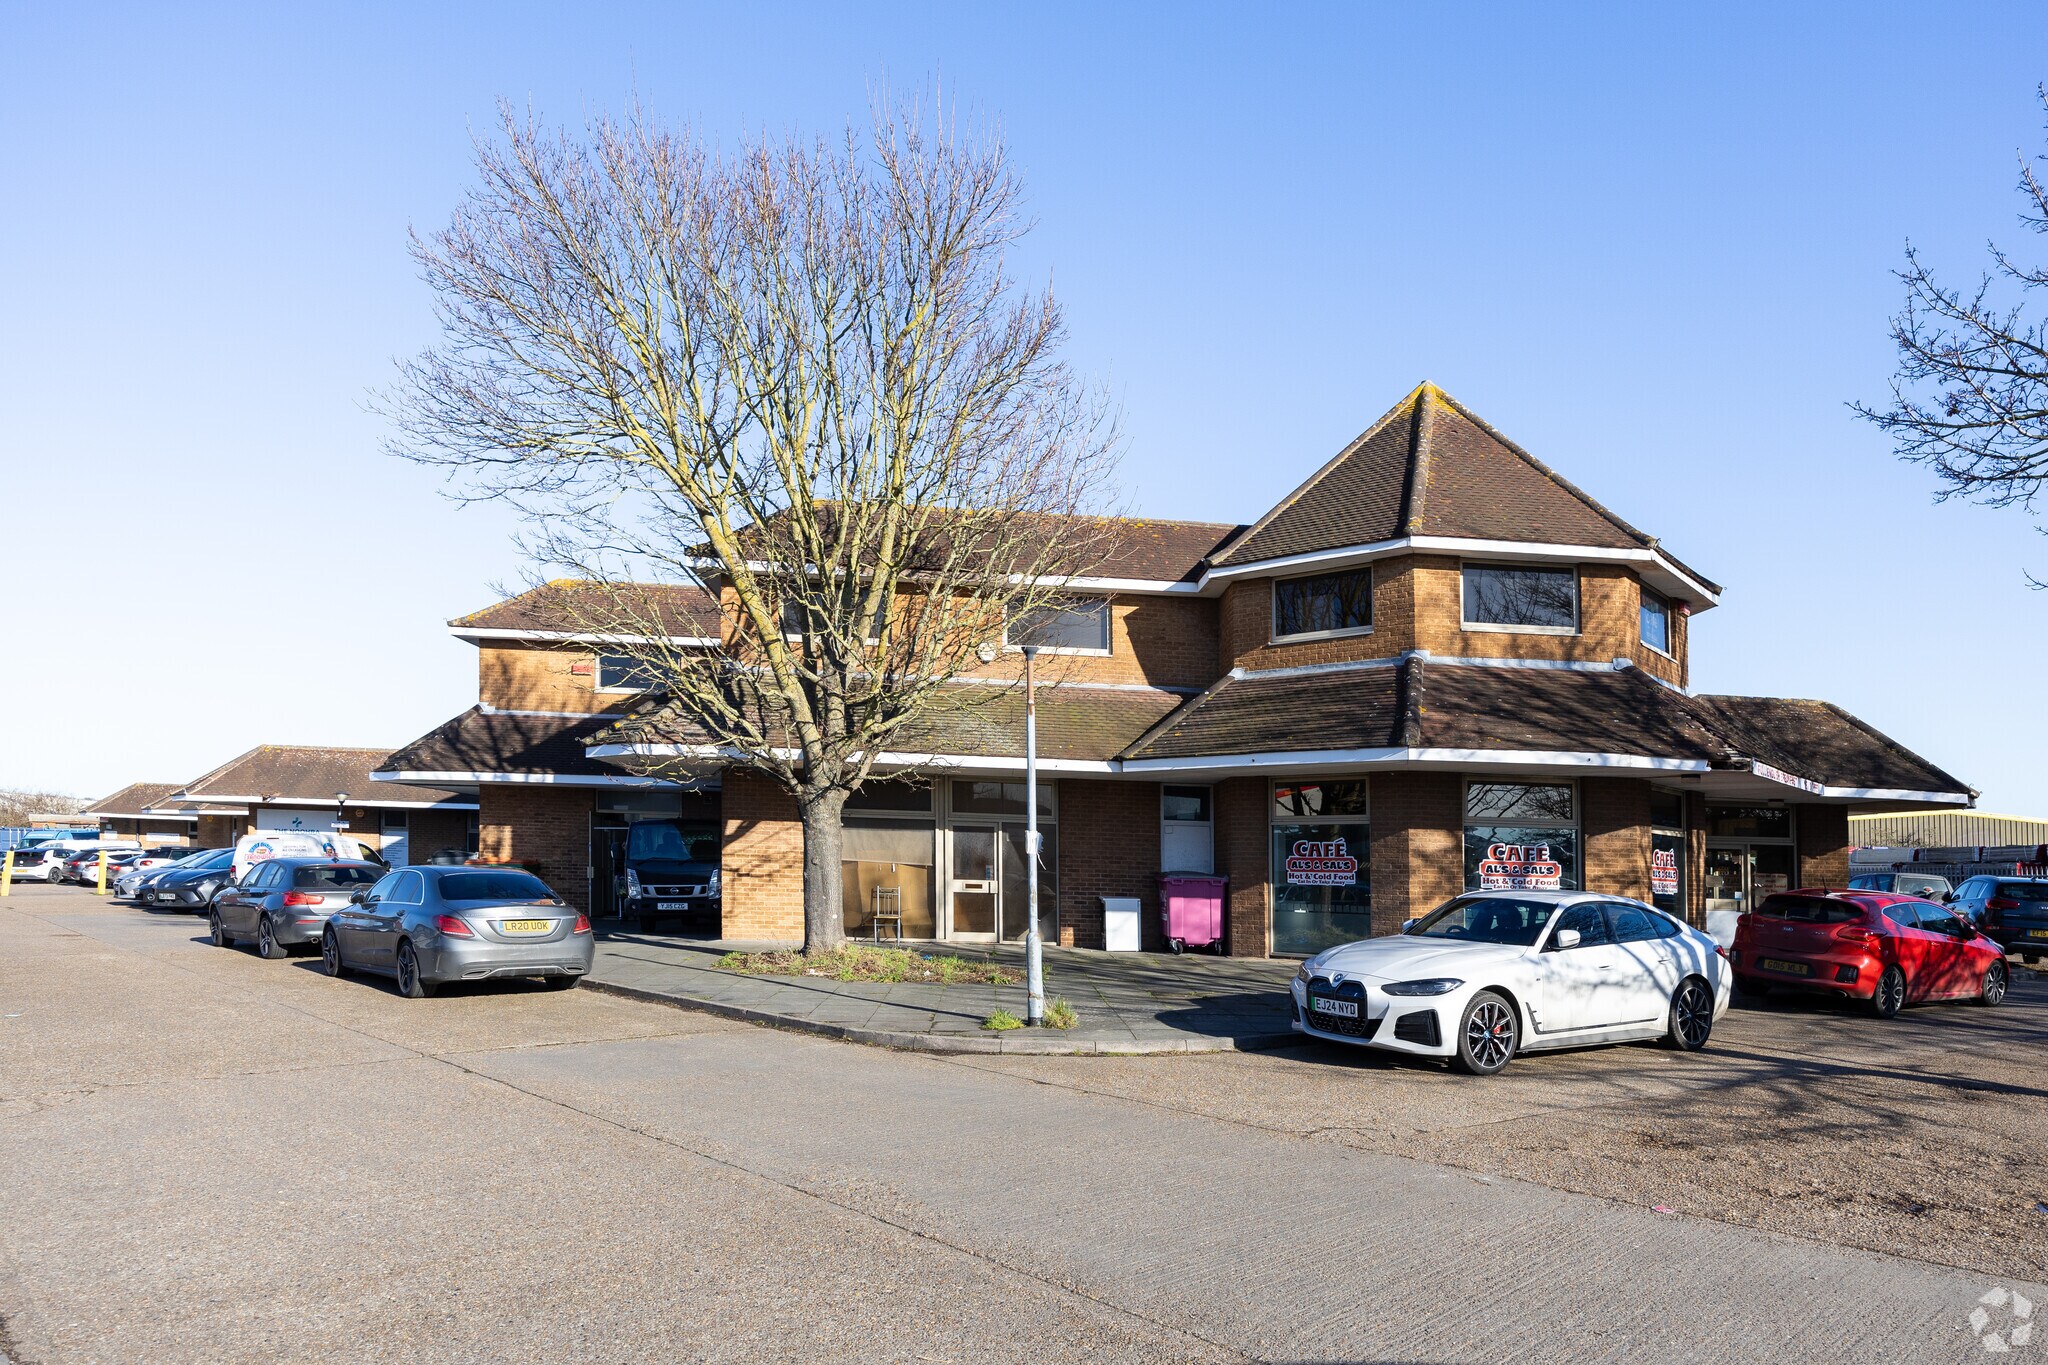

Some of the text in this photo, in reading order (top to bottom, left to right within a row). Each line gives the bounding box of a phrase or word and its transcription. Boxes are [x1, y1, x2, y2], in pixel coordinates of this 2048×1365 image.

[1293, 837, 1347, 858] CAFÉ
[1488, 842, 1549, 862] CAFÉ
[1653, 848, 1675, 867] CAFÉ
[1291, 861, 1351, 870] AL'S & SAL'S
[1485, 865, 1554, 875] AL'S & SAL'S
[1288, 872, 1303, 880] Hot
[1304, 872, 1311, 880] &
[1333, 873, 1355, 881] Food
[504, 921, 549, 931] LR20 UOK
[1316, 998, 1356, 1015] EJ24 NYD
